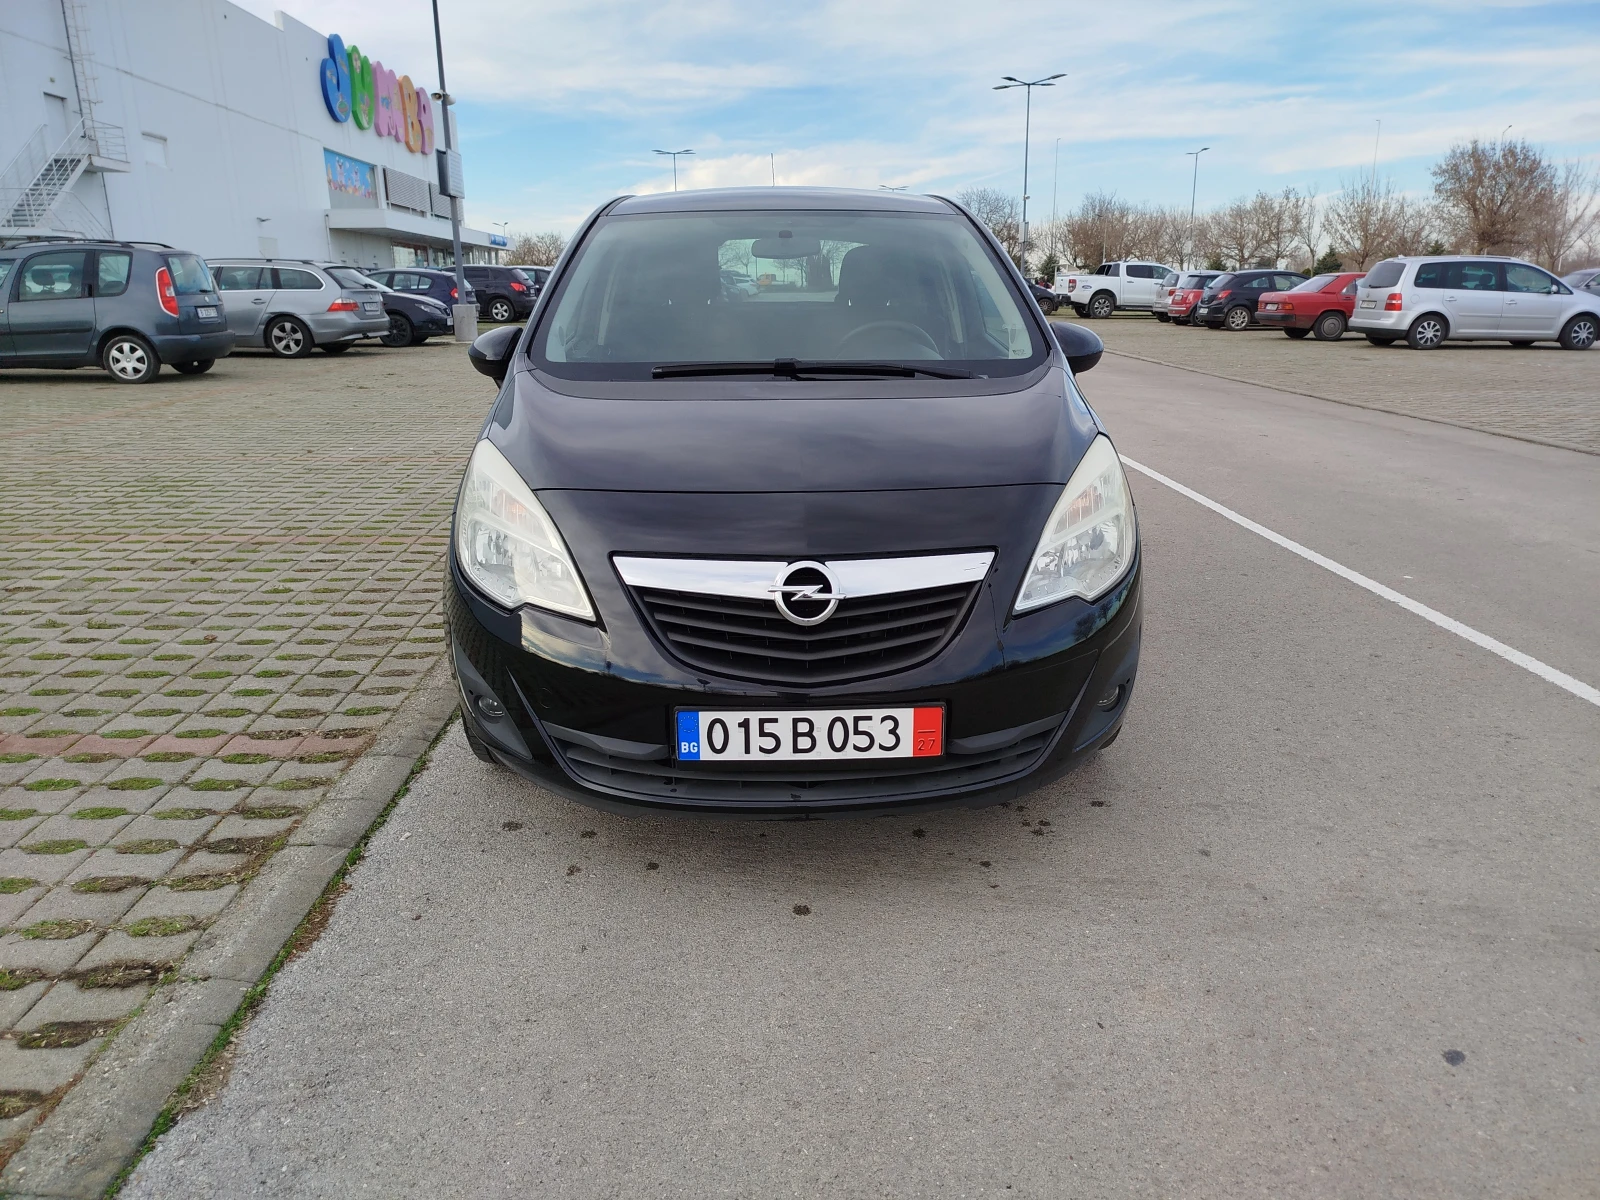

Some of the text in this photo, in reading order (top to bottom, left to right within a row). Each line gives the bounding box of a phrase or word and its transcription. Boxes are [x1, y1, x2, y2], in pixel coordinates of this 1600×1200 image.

[320, 33, 434, 155] JUMBO
[681, 742, 698, 753] BG
[917, 737, 936, 751] 27
